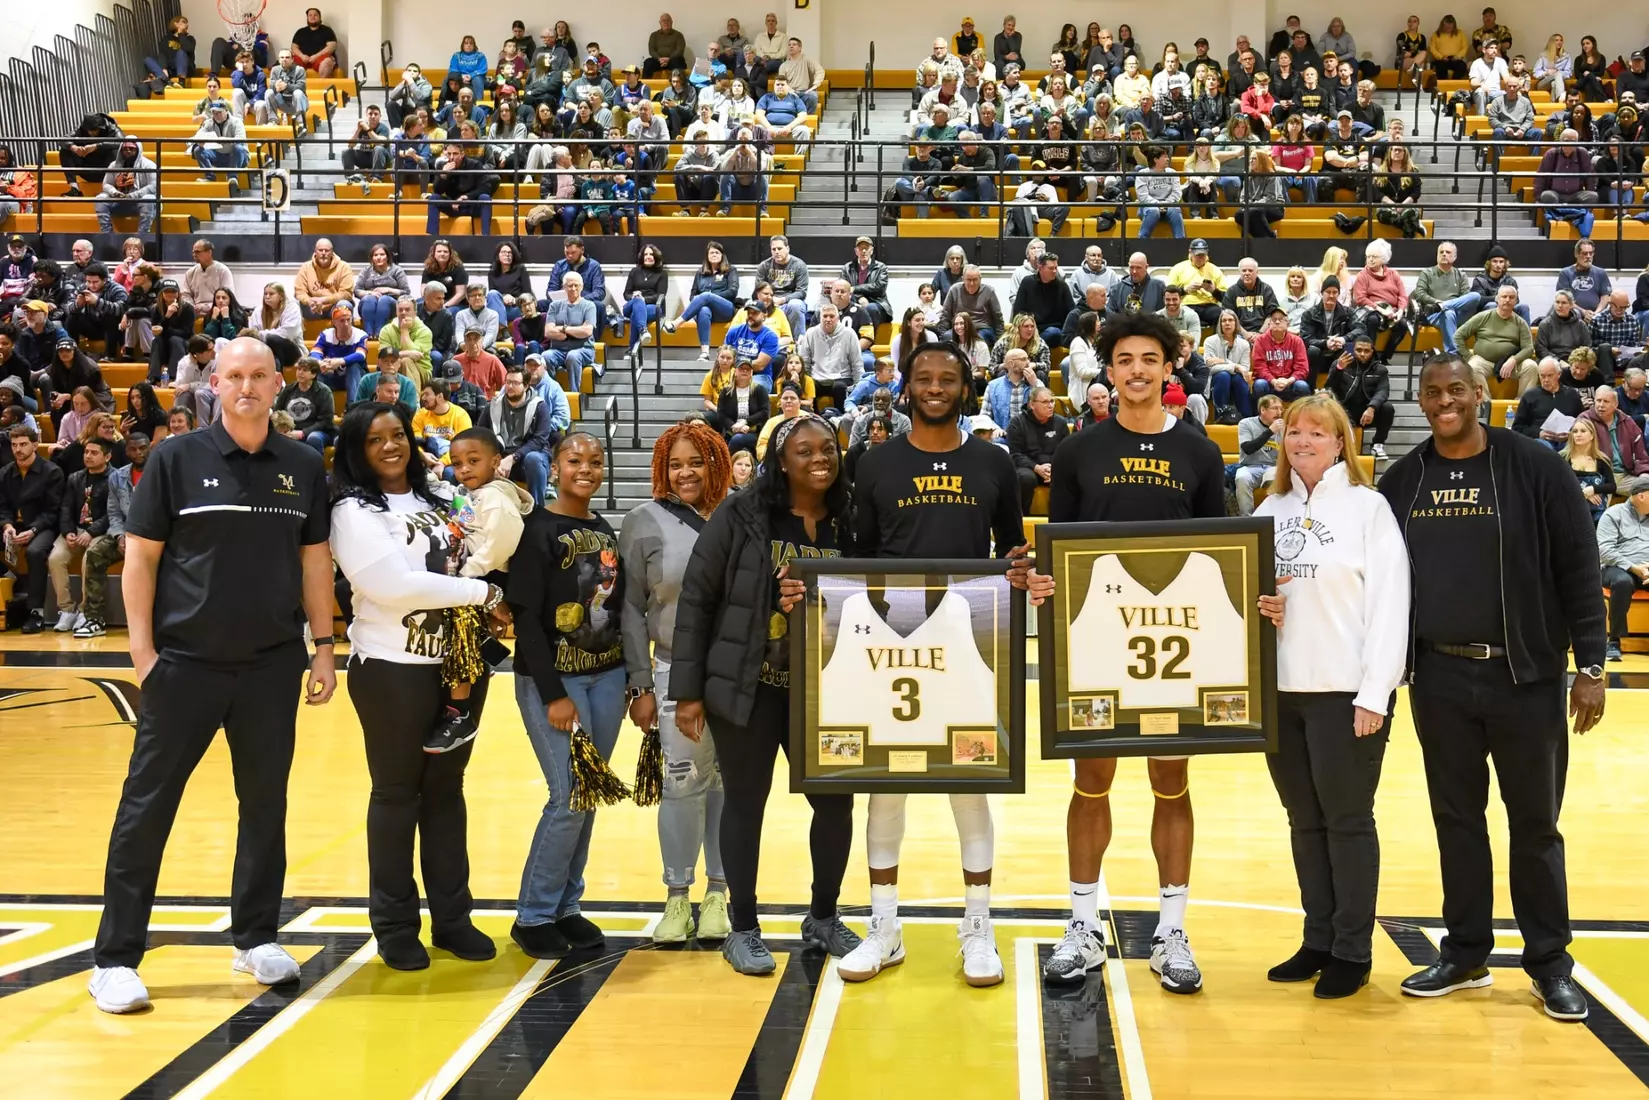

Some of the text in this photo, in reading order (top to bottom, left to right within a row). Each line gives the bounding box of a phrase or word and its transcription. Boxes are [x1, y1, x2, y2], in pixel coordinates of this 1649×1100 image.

[1120, 457, 1171, 478] VILLE
[912, 475, 963, 494] VILLE
[1103, 474, 1186, 492] BASKETBALL
[897, 494, 978, 508] BASKETBALL
[1430, 487, 1481, 506] VILLE
[1411, 506, 1495, 518] BASKETBALL
[1117, 605, 1200, 631] VILLE
[864, 646, 947, 673] VILLE
[1127, 635, 1192, 681] 32
[891, 676, 922, 722] 3
